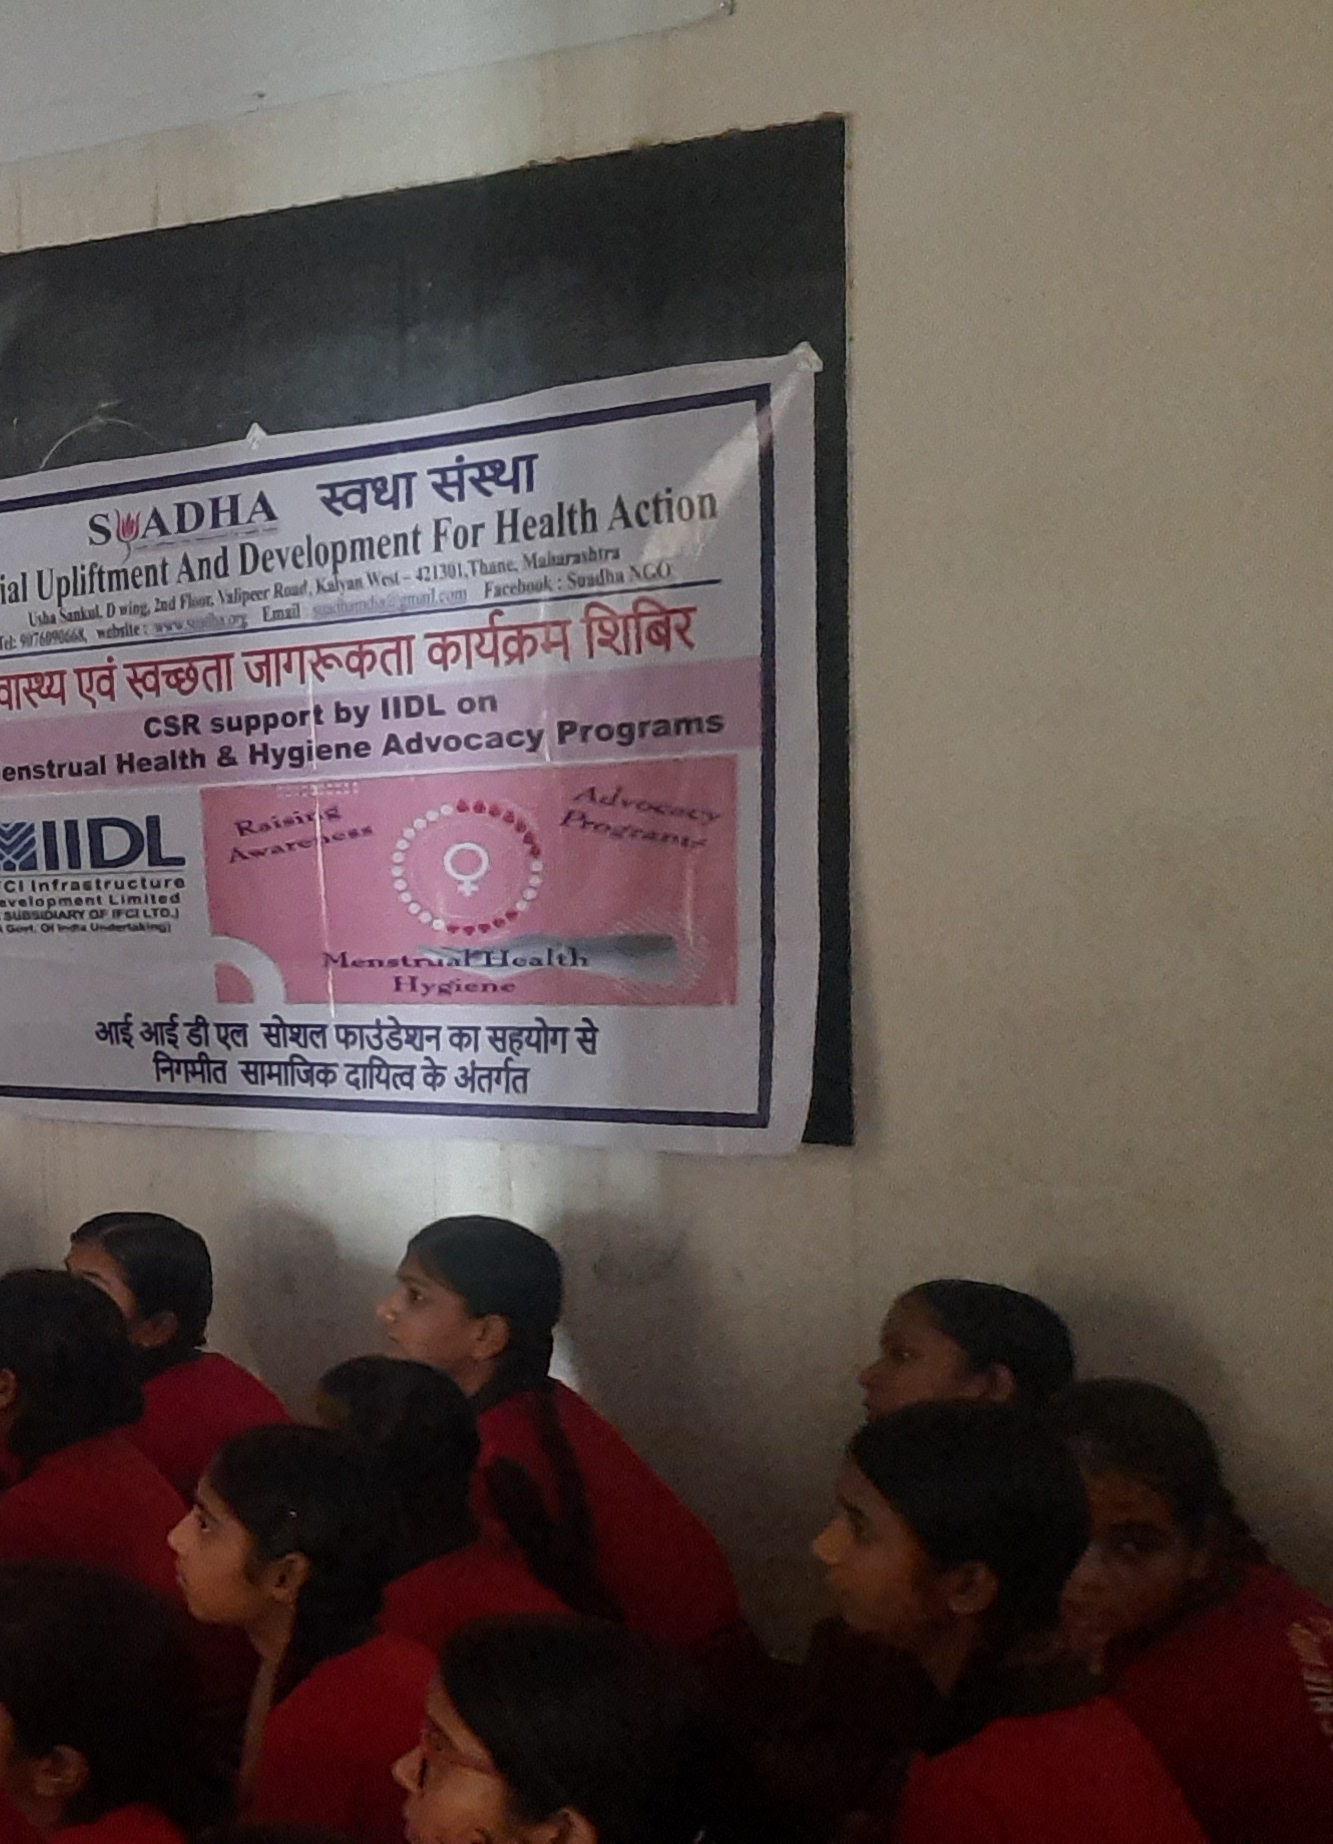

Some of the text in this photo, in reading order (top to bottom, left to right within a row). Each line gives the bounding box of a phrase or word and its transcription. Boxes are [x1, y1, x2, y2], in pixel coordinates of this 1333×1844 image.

[316, 453, 540, 518] स्वधा संस्था
[36, 556, 170, 608] Upliftment
[177, 545, 230, 585] And
[239, 523, 422, 577] Development
[433, 516, 486, 553] For
[496, 497, 599, 546] Health
[608, 486, 719, 532] Action
[106, 603, 116, 619] D
[154, 594, 176, 612] 2nd
[315, 574, 363, 595] Kalyan
[366, 570, 400, 588] West
[261, 603, 301, 623] Email
[483, 571, 553, 600] Facebook
[629, 562, 671, 582] NGO
[73, 655, 117, 709] एवं
[123, 652, 235, 700] स्वच्छता
[241, 633, 416, 689] जागरूकता
[423, 608, 572, 673] कार्यक्रम
[579, 596, 698, 660] शिबिर
[144, 693, 498, 739] CSR support by IIDL on
[117, 747, 207, 775] Health
[216, 744, 239, 768] &
[249, 737, 372, 771] Hygiene
[381, 726, 545, 758] Advocacy
[556, 712, 725, 746] Programs
[233, 805, 342, 838] Raising
[572, 785, 721, 826] Advocacy
[42, 814, 186, 871] IIDL
[229, 825, 374, 864] Awareness
[31, 876, 186, 893] Infrastructure
[109, 892, 181, 906] Limited
[3, 908, 85, 922] SUBSIDIARY
[322, 947, 589, 969] Menstrual Health
[393, 975, 516, 997] Hygiene
[95, 1012, 135, 1049] आई
[139, 1012, 180, 1050] आई
[183, 1014, 210, 1048] डी
[213, 1021, 249, 1051] एल
[259, 1014, 329, 1050] सोशल
[447, 1025, 482, 1053] का
[485, 1016, 571, 1057] सहयोग
[574, 1016, 600, 1055] से
[237, 1052, 340, 1088] सामाजिक
[344, 1054, 417, 1091] दायित्व
[420, 1055, 448, 1092] के
[454, 1056, 531, 1095] अंतर्गत
